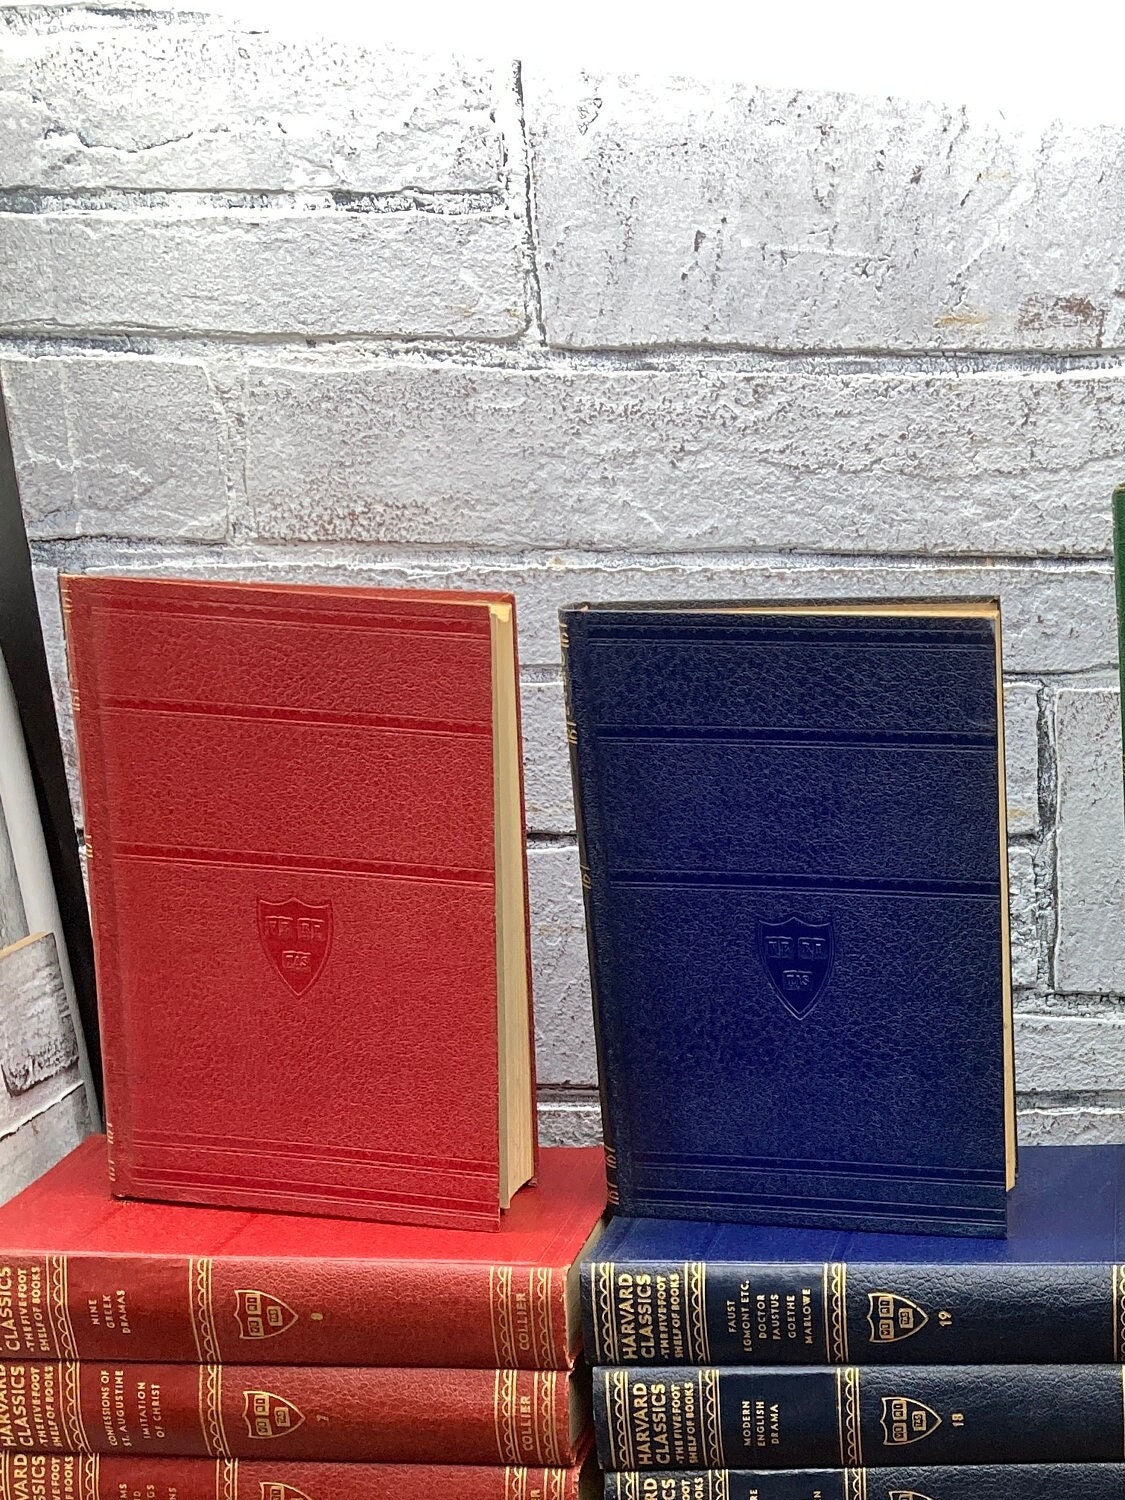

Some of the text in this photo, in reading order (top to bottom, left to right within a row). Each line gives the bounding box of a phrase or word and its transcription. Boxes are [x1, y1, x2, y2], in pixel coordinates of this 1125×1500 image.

[619, 1274, 637, 1359] HARVARD
[636, 1274, 655, 1357] CLASSICS
[757, 1294, 767, 1338] DOCTOR
[787, 1295, 796, 1337] GOETHE
[939, 1311, 952, 1326] 19
[633, 1383, 651, 1465] HARVARD
[651, 1384, 670, 1464] CLASSICS
[742, 1401, 751, 1446] MODERN
[756, 1401, 765, 1446] ENGLISH
[769, 1404, 779, 1444] DRAMA
